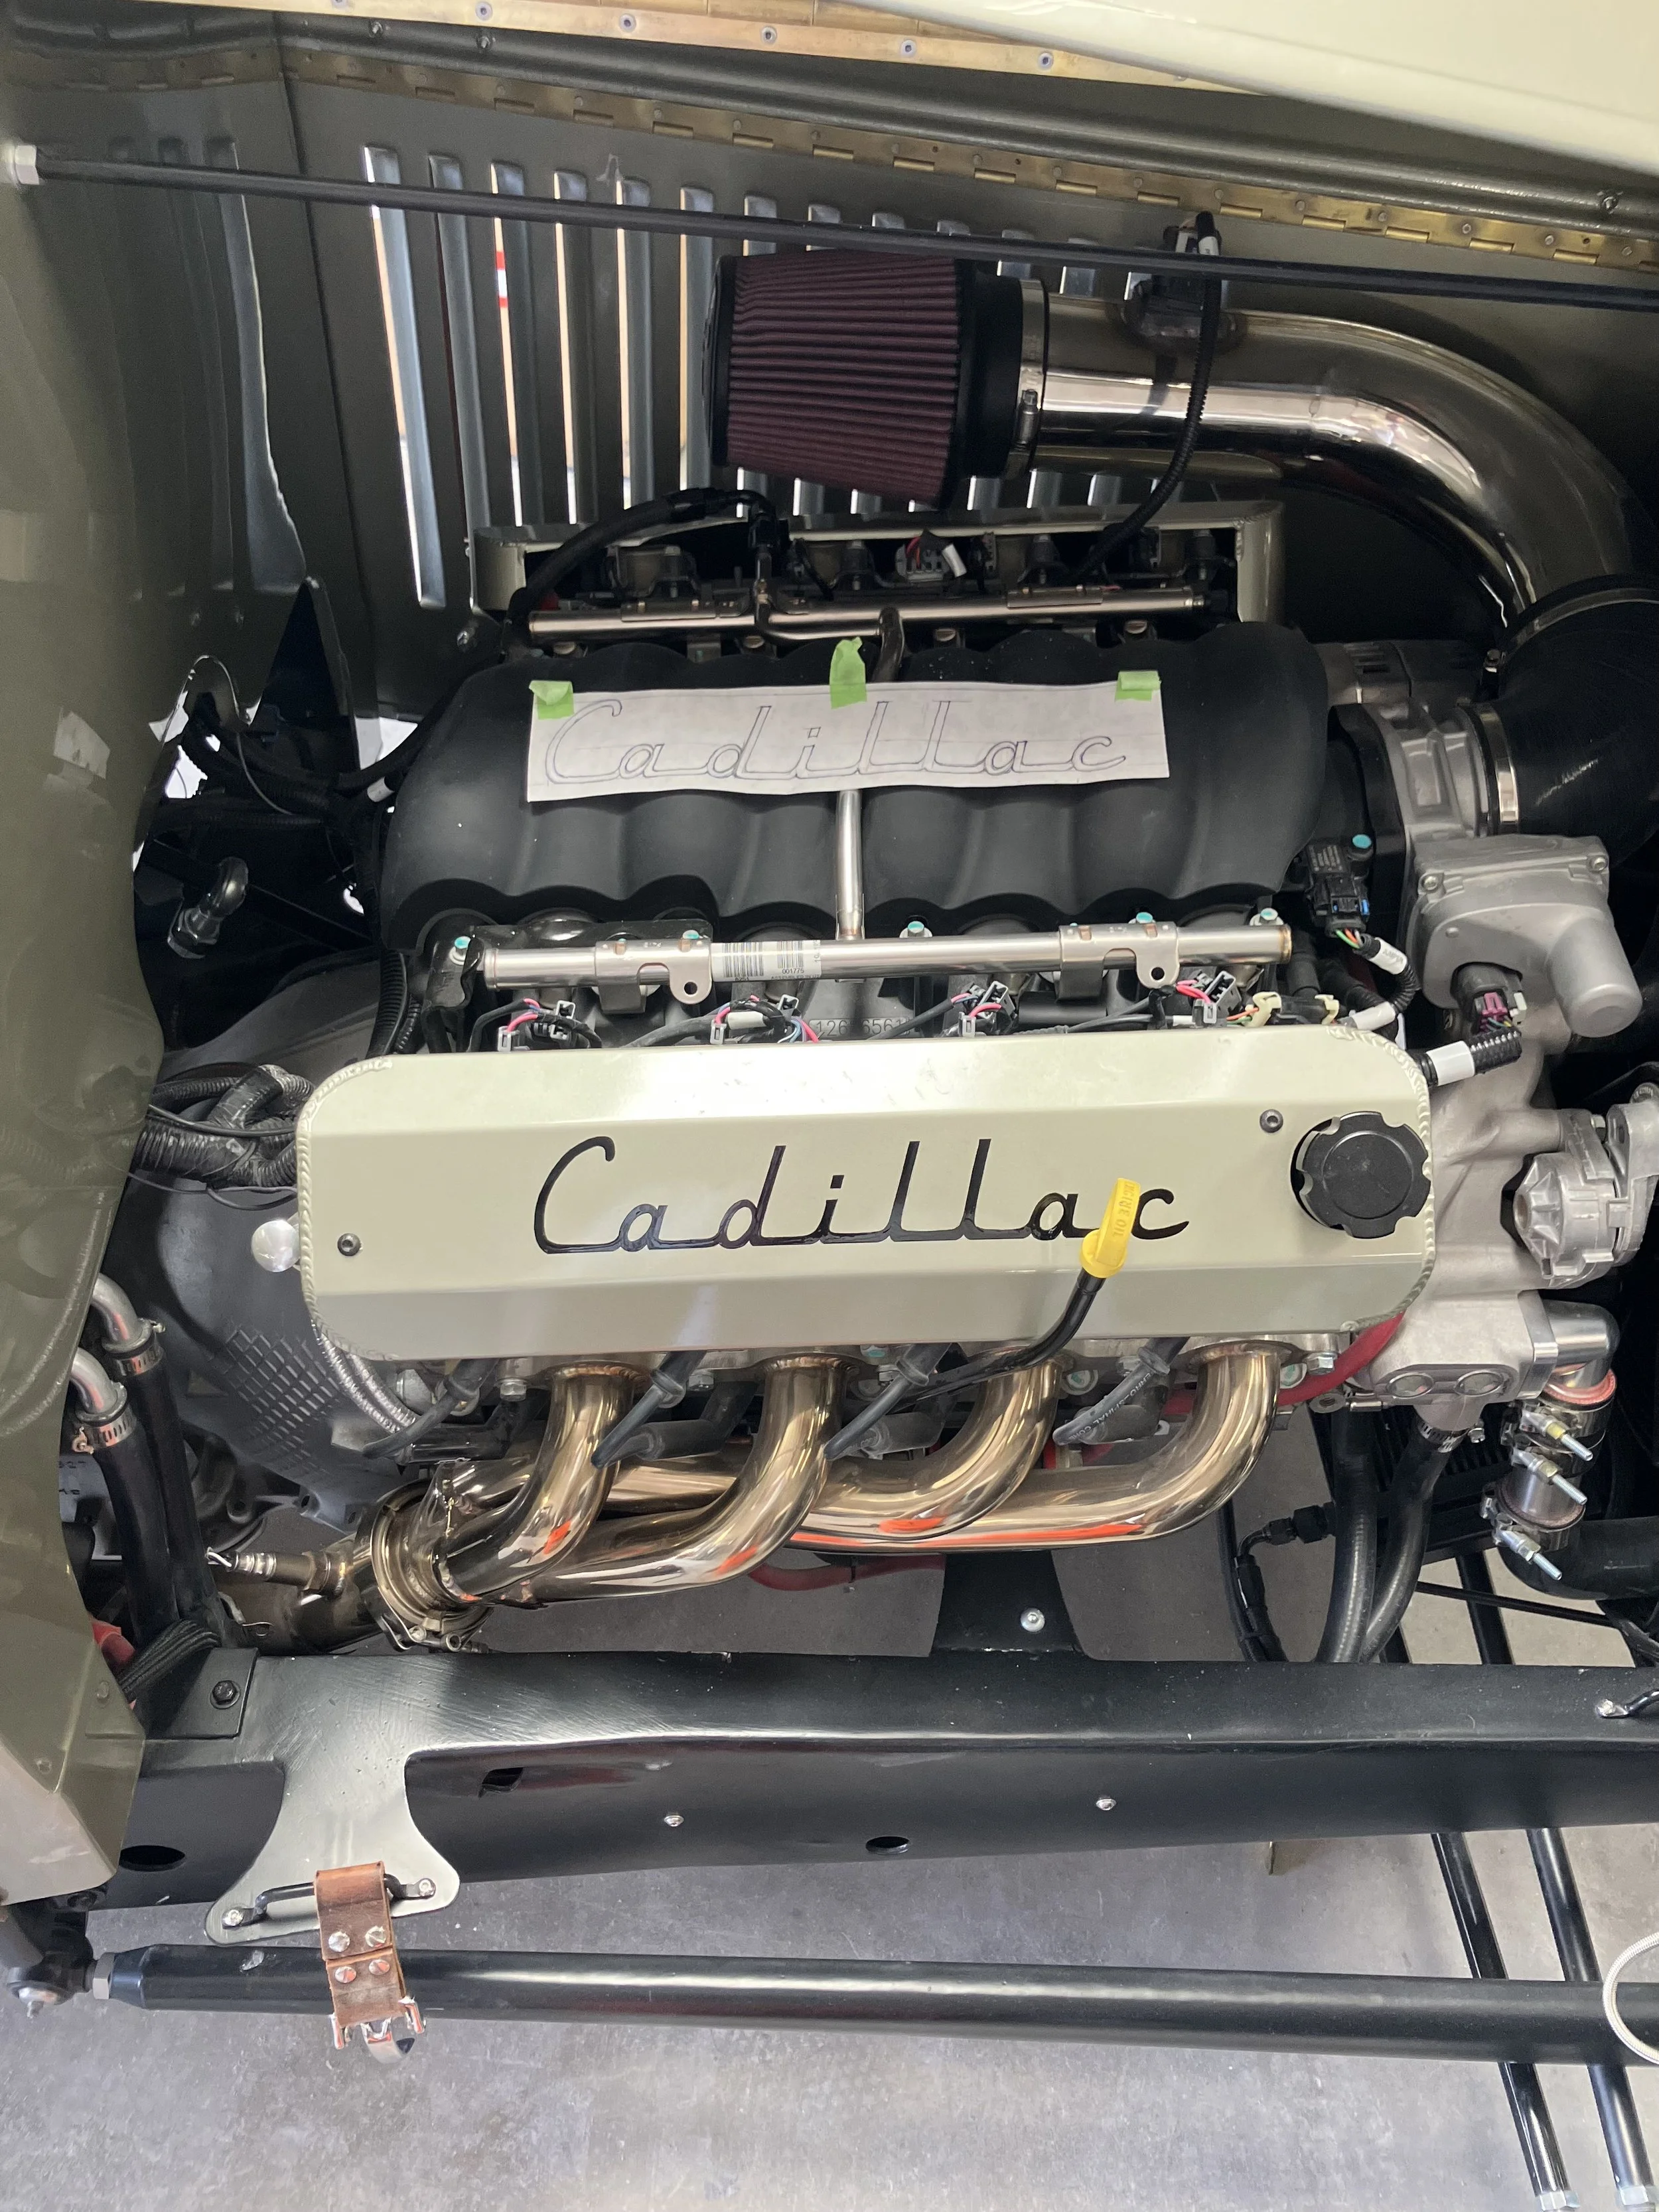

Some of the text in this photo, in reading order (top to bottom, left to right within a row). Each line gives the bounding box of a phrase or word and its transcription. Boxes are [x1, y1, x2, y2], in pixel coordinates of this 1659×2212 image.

[543, 699, 1126, 783] Cadillac
[816, 1018, 901, 1037] 1266561
[534, 1136, 1190, 1254] Cadillac
[1112, 1218, 1126, 1237] OIL
[1092, 1372, 1152, 1425] ERRO-SPIRAL
